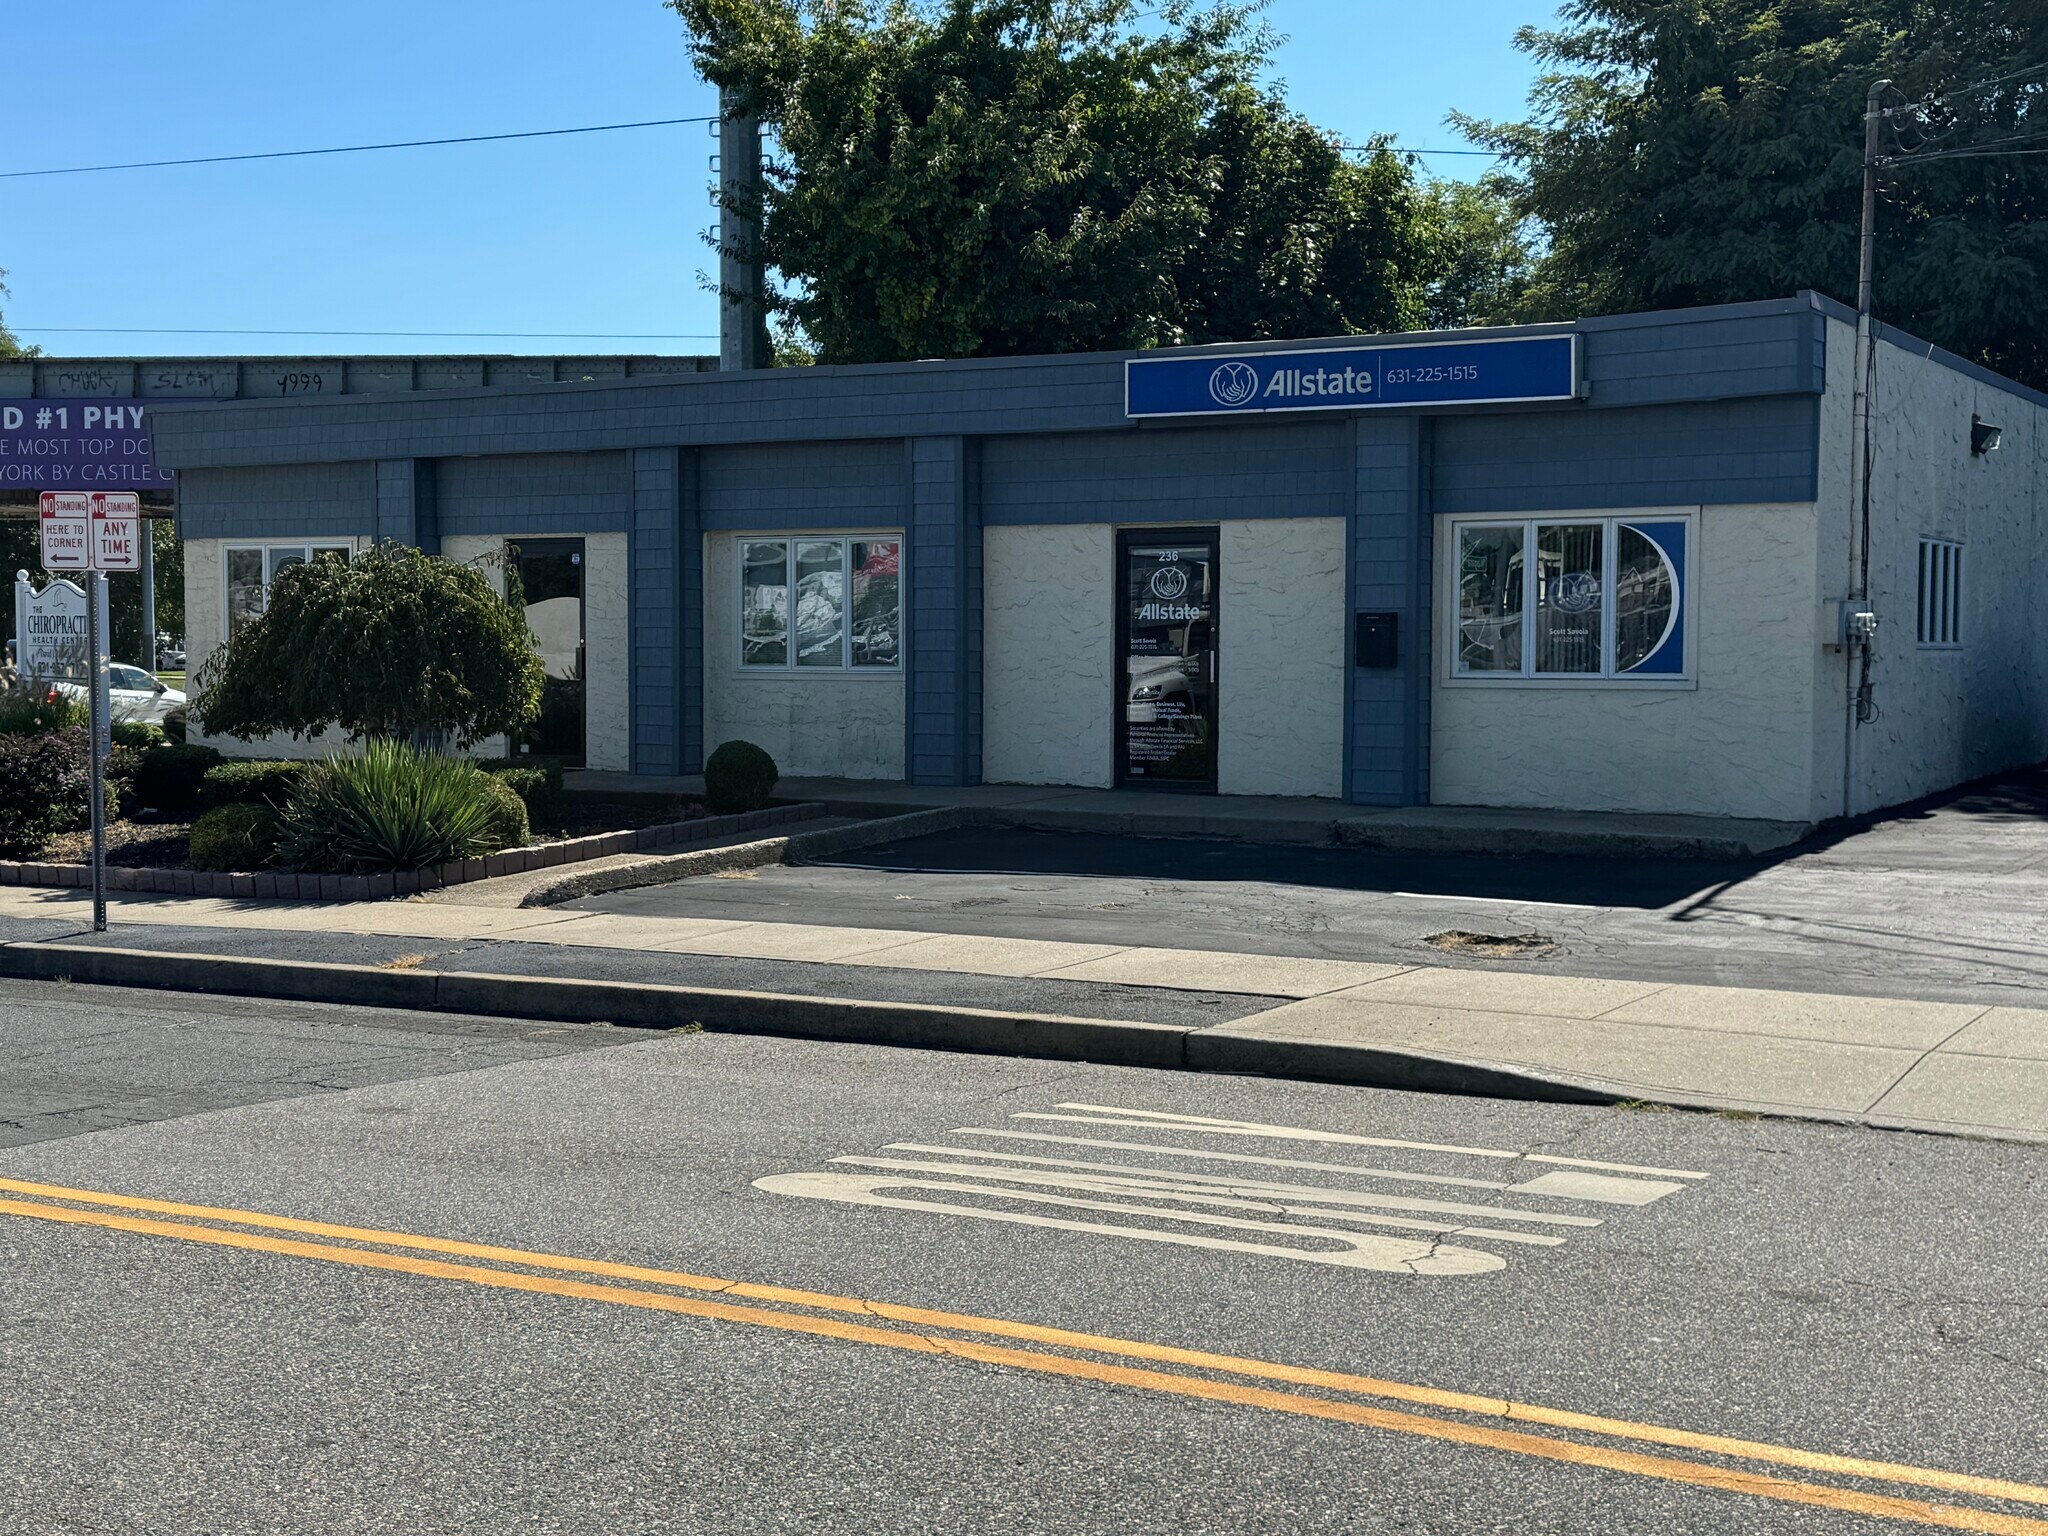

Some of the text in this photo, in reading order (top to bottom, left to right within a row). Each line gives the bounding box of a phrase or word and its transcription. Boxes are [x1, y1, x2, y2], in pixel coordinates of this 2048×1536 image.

[1263, 365, 1478, 398] Allstate 631-225-1515
[35, 407, 68, 430] #1
[83, 406, 144, 429] PHY
[17, 438, 71, 455] MOST
[77, 438, 114, 455] TOP
[52, 464, 74, 480] BY
[81, 464, 151, 481] CASTLE
[42, 498, 86, 513] NO STANDING
[92, 498, 136, 514] NO STANDING
[46, 525, 84, 535] HERE TO
[103, 522, 128, 536] ANY
[48, 538, 83, 548] CORNER
[101, 540, 131, 554] TIME
[1158, 551, 1179, 561] 236
[33, 606, 42, 614] THE
[1138, 604, 1200, 620] Allstate
[32, 636, 58, 644] HEALTH
[751, 1102, 1710, 1277] ONLY
